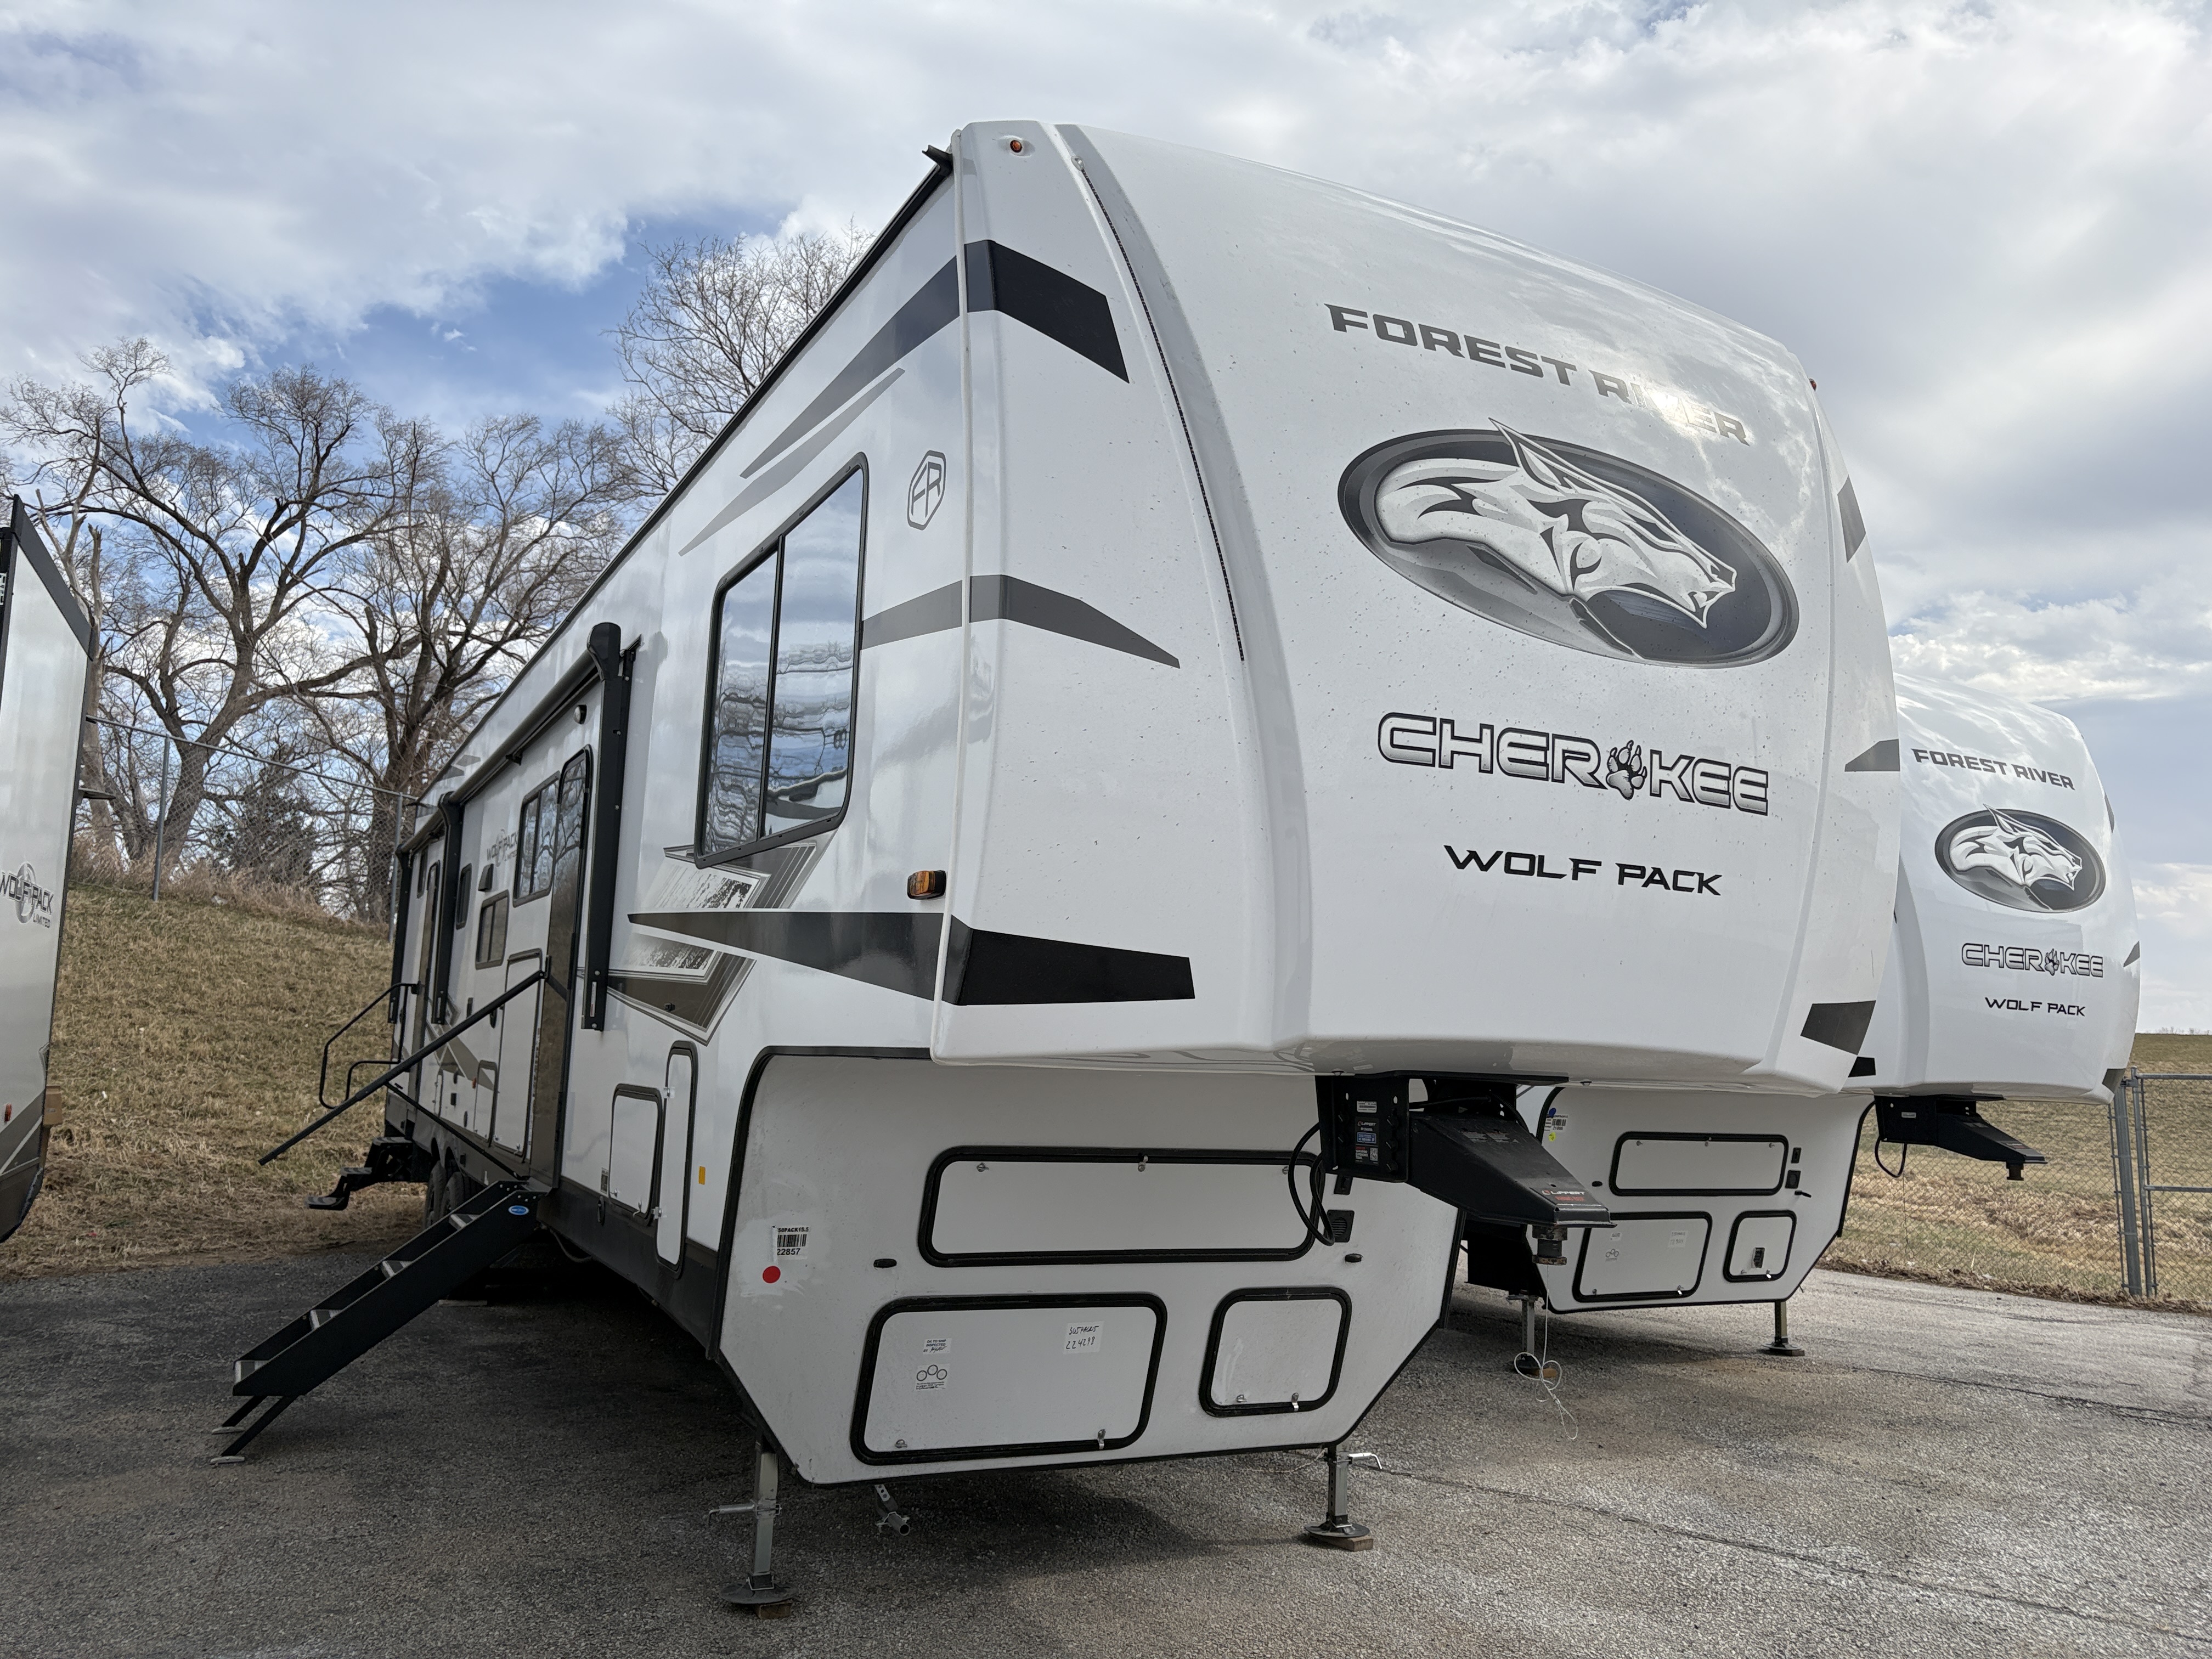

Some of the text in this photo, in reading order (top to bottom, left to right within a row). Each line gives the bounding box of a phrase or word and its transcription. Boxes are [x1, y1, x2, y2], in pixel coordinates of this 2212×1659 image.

[1324, 303, 1577, 386] FOREST
[1911, 748, 2075, 790] FOREST RIVER
[1443, 845, 1723, 896] WOLF PACK
[31, 883, 54, 915] PACK
[1985, 997, 2086, 1017] WOLF PACK
[777, 1248, 801, 1256] 22857
